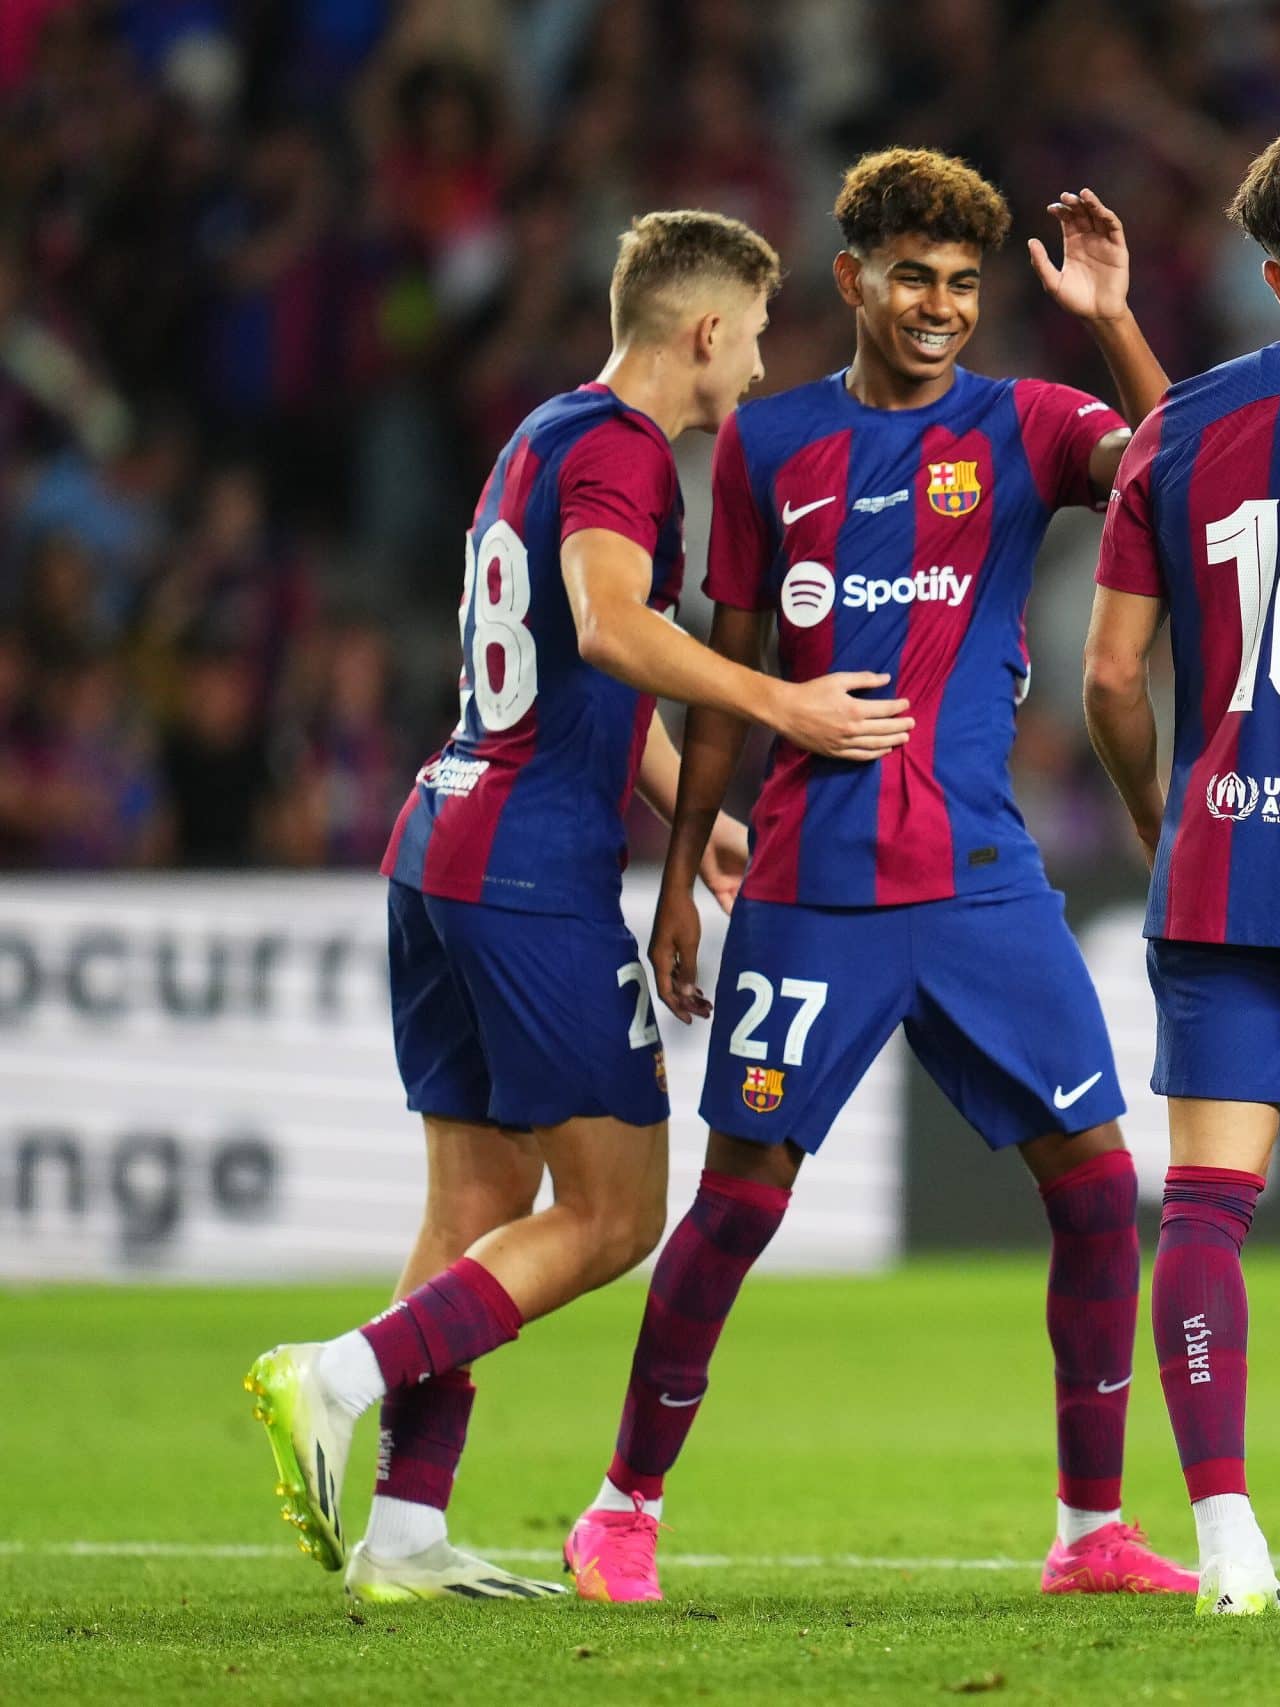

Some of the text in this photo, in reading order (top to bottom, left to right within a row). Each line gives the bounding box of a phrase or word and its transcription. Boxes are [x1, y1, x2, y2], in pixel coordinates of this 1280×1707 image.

[842, 565, 973, 613] Spotify
[1262, 815, 1276, 823] The
[729, 970, 829, 1067] 27
[1183, 1313, 1213, 1385] BARÇA
